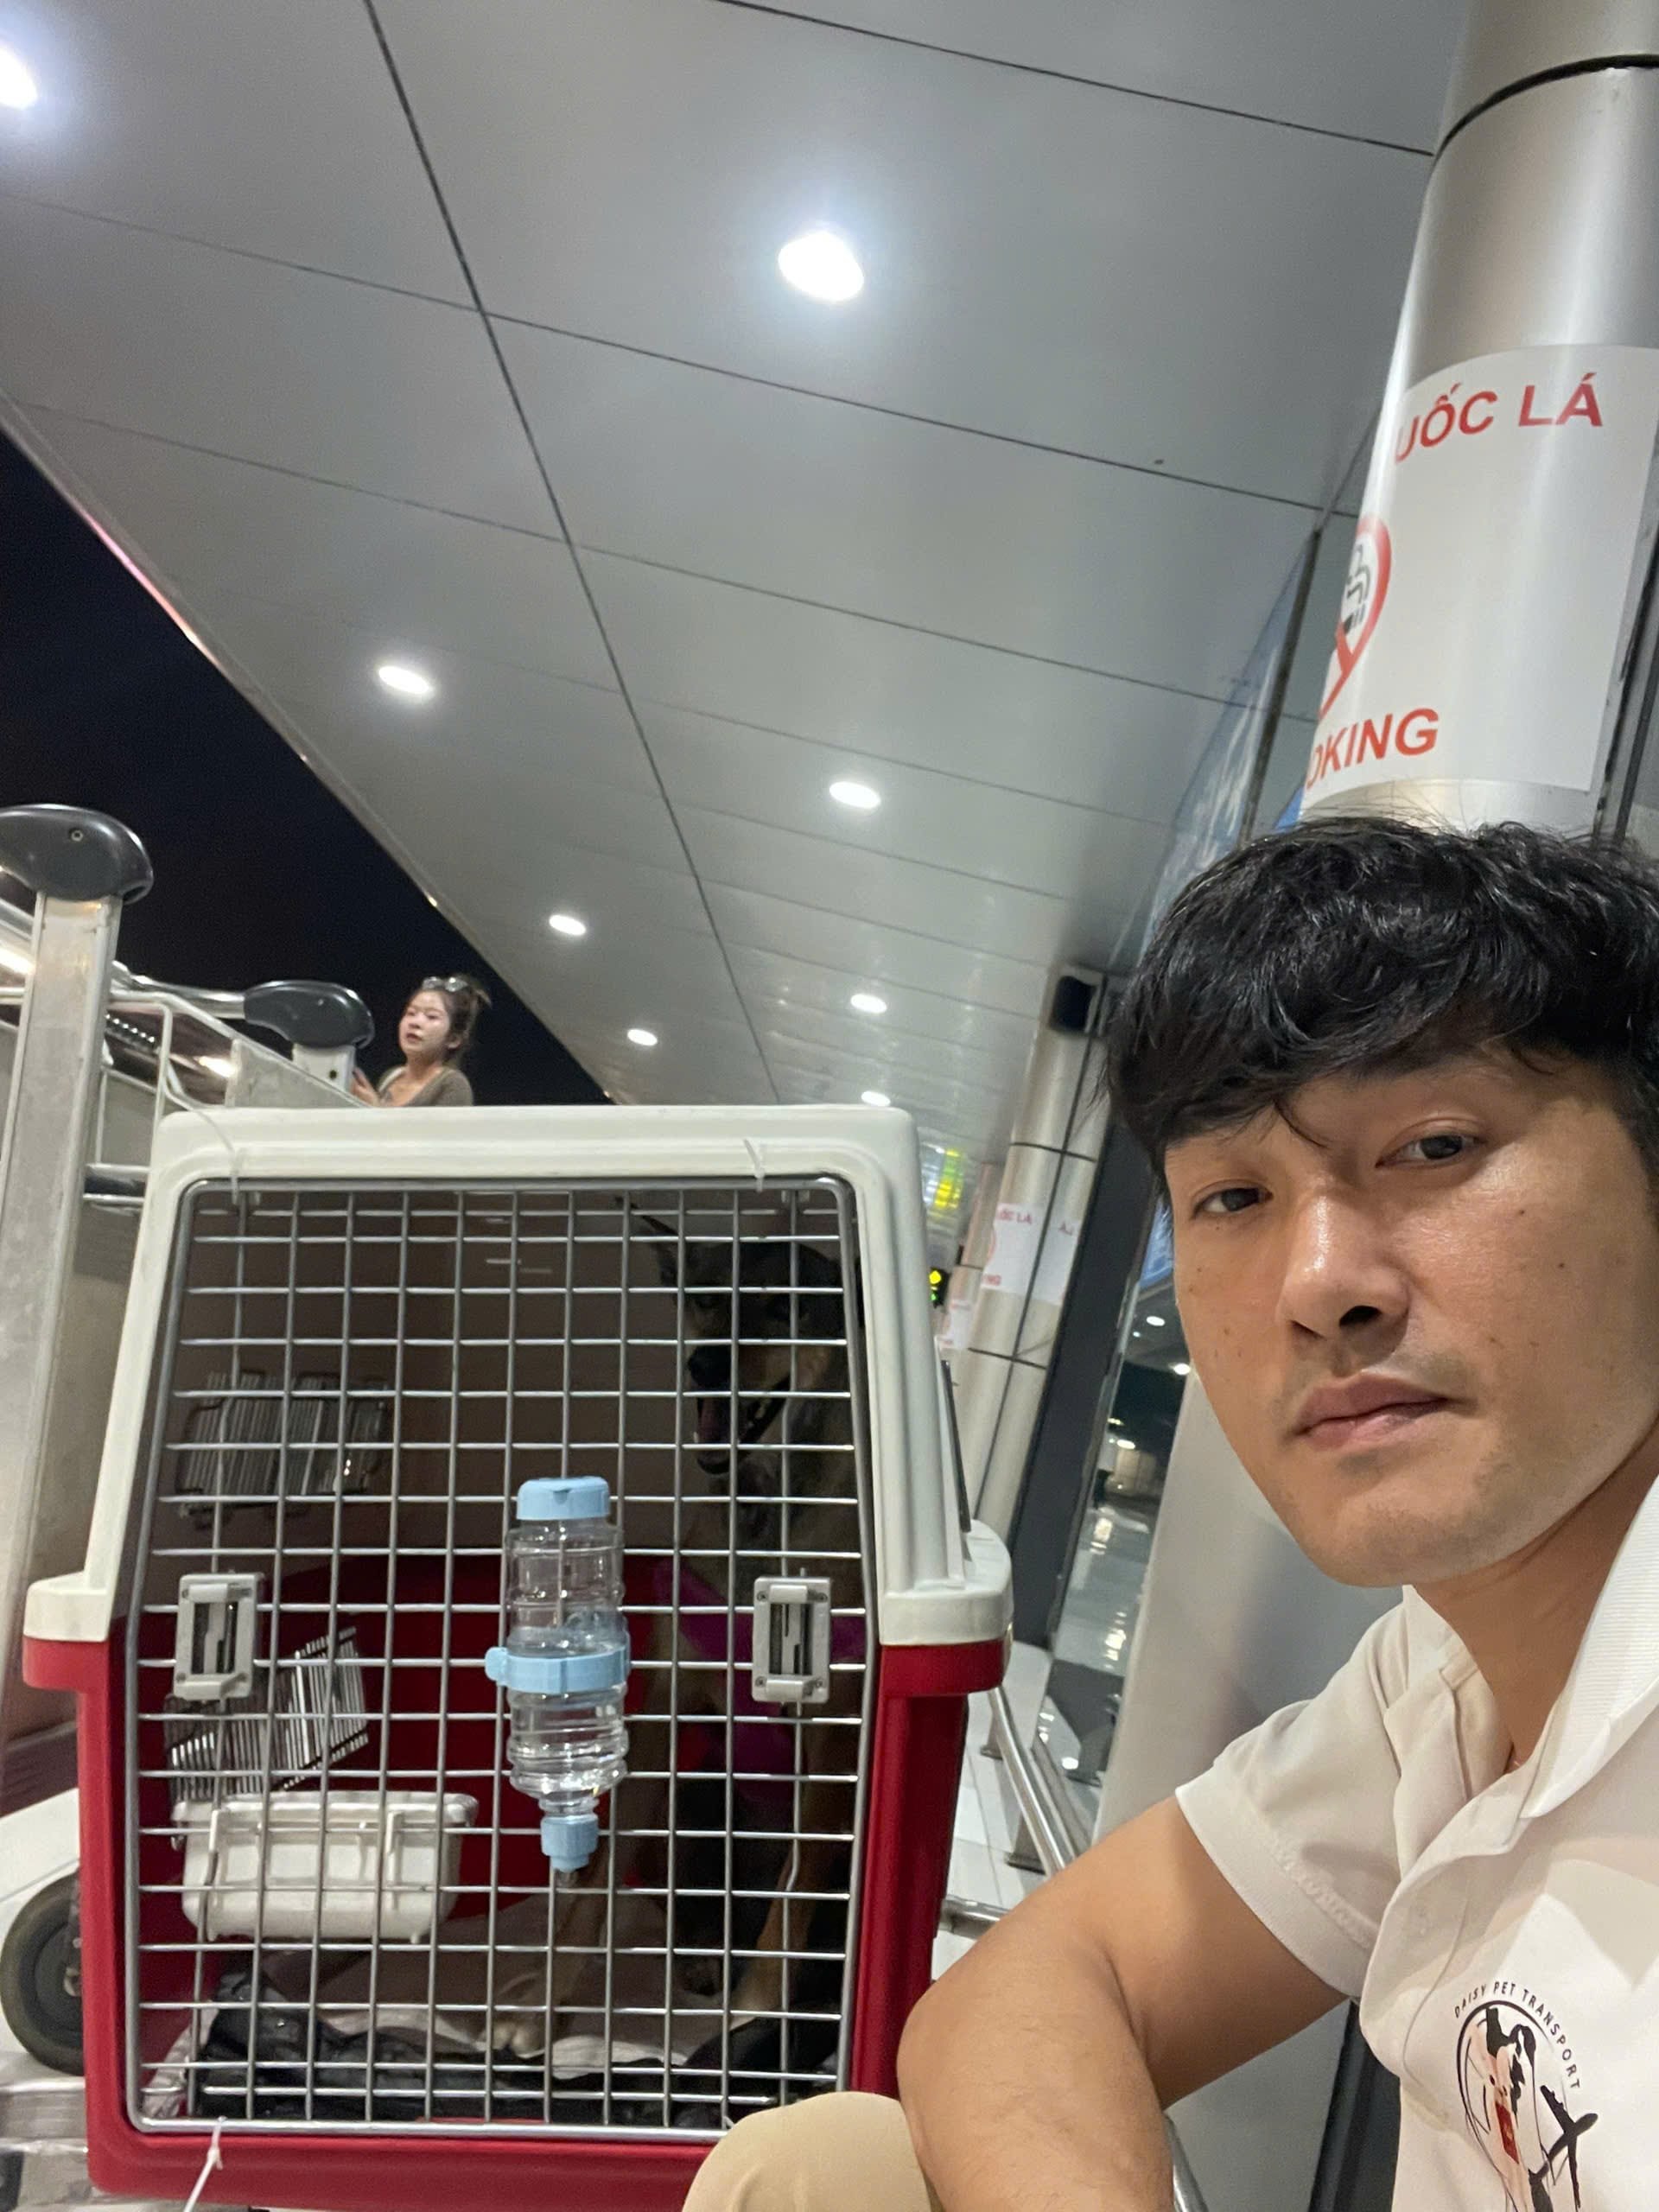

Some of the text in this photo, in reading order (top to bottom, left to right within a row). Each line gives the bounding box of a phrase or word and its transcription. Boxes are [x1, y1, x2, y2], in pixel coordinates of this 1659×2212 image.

[1518, 372, 1603, 426] LÁ
[1454, 1981, 1580, 2088] DAISY PET TRANSPORT
